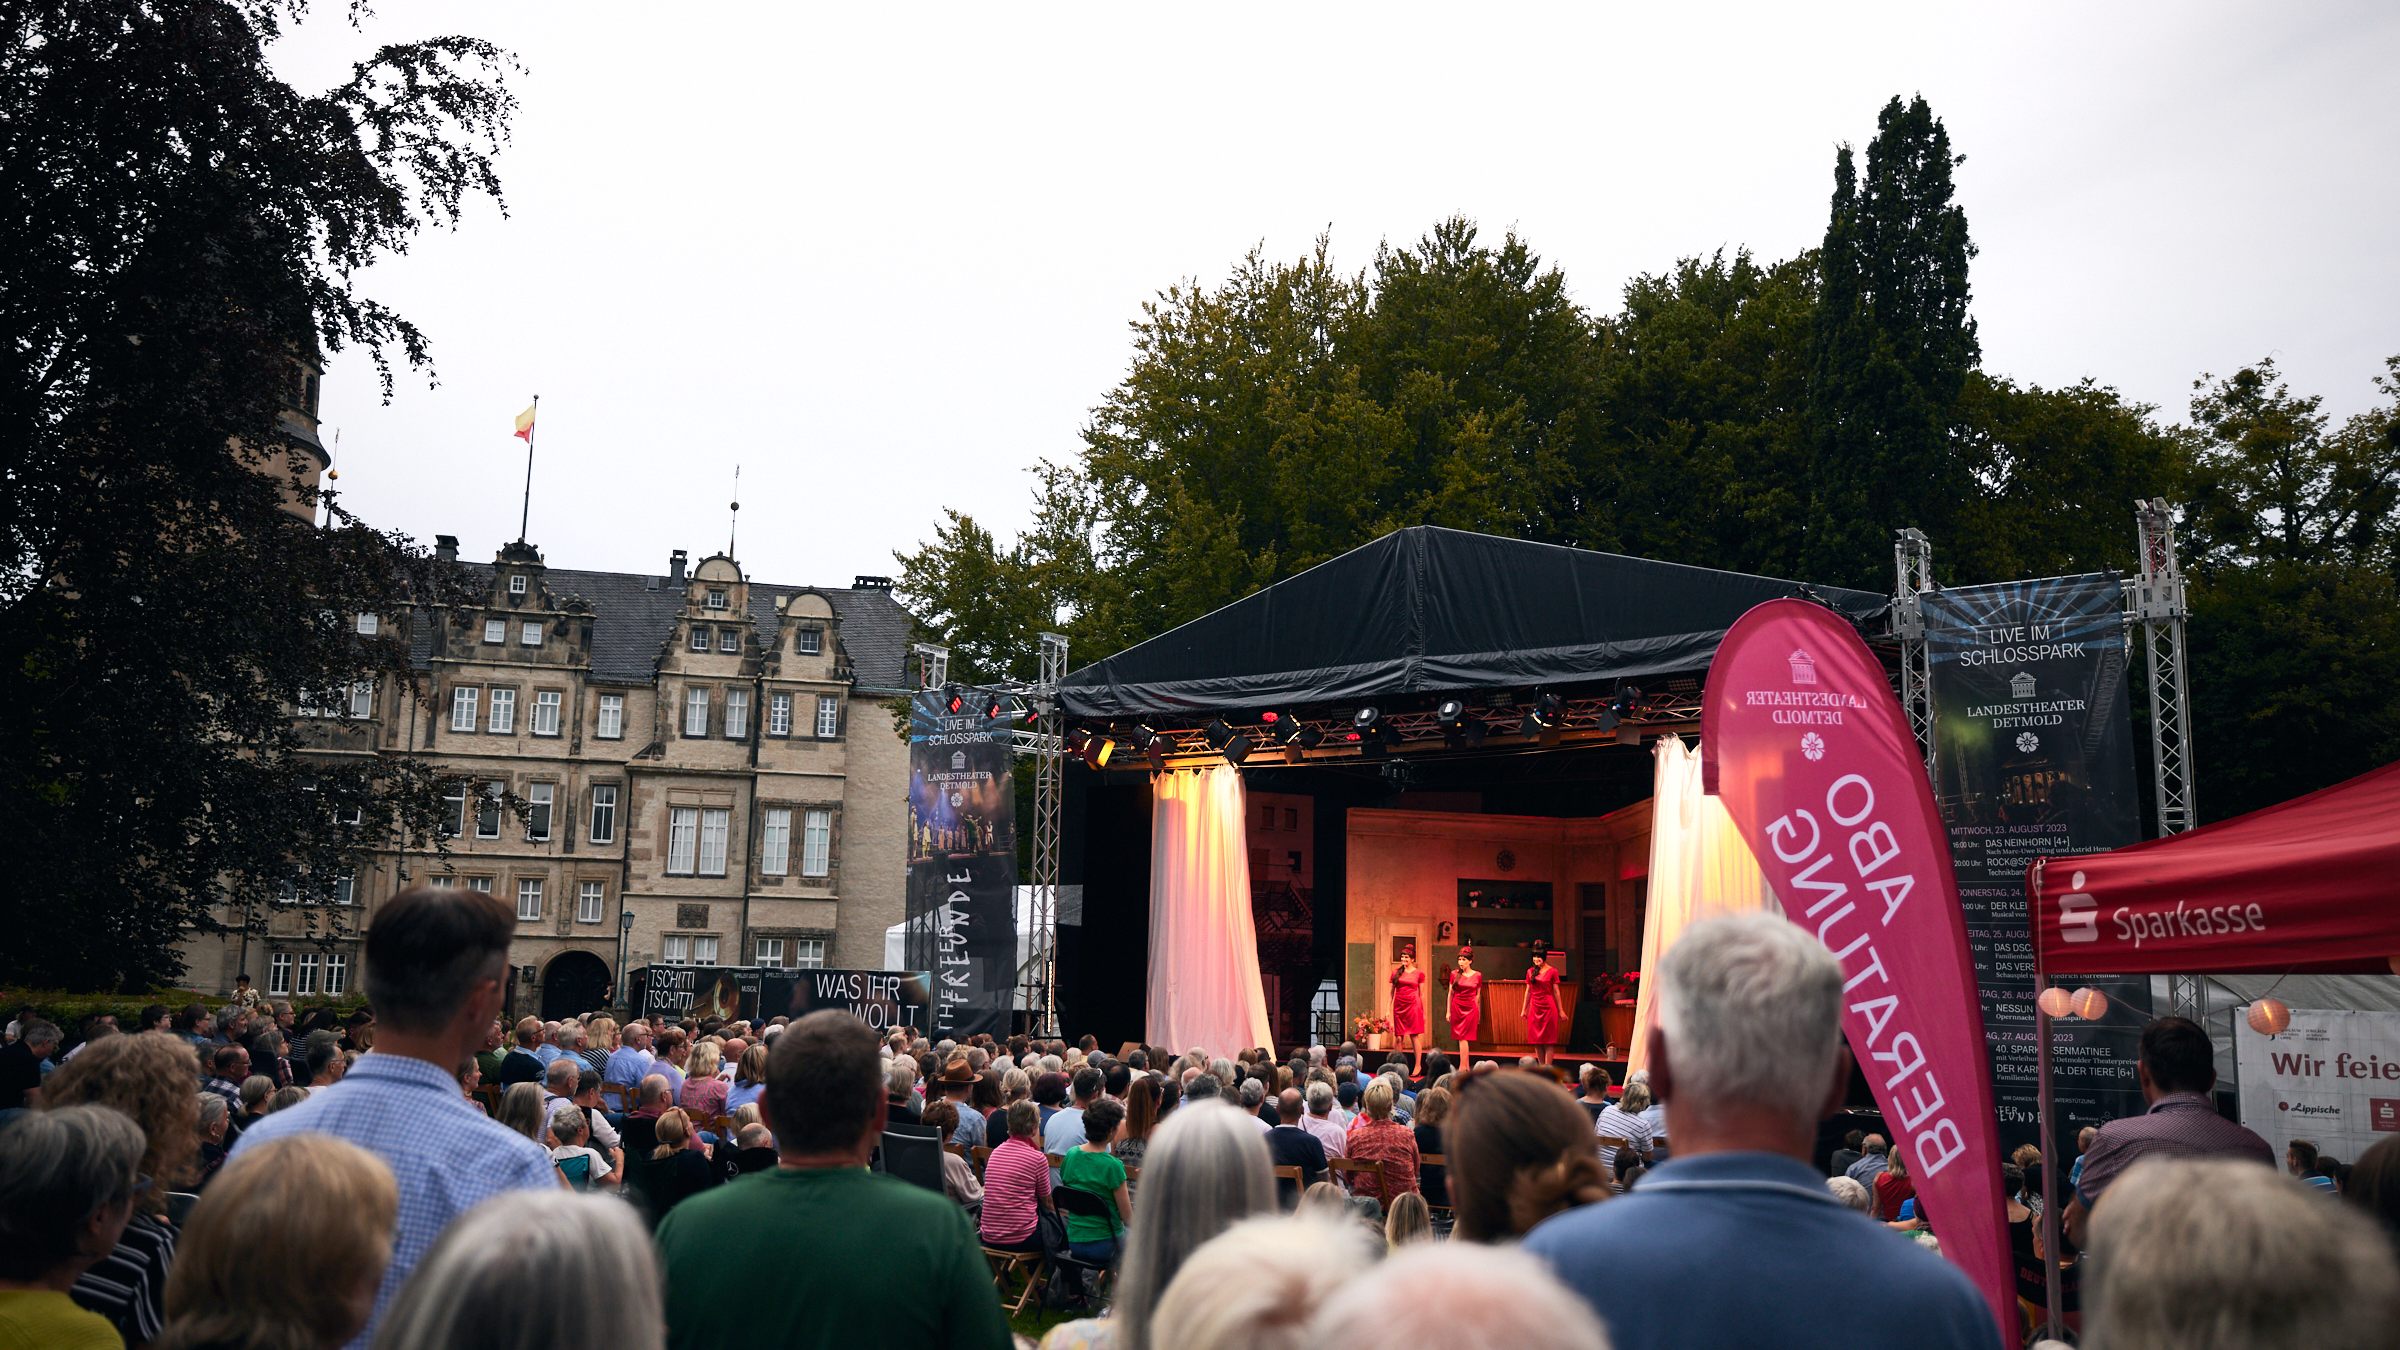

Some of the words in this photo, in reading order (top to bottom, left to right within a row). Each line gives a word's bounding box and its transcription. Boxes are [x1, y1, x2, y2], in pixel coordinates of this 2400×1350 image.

[1990, 626, 2026, 644] LIVE
[2030, 625, 2050, 641] IM
[1960, 642, 2086, 667] SCHLOSSPARK
[1967, 699, 2086, 717] LANDESTHEATER
[944, 719, 964, 731] LIVE
[965, 718, 975, 730] IM
[1993, 714, 2063, 728] DETMOLD
[928, 731, 994, 746] SCHLOSSPARK
[927, 771, 993, 782] LANDESTHEATER
[940, 781, 978, 790] DETMOLD
[1951, 826, 1994, 835] MITTWOCH,
[1995, 825, 2007, 834] 23.
[2009, 824, 2045, 834] AUGUST
[2046, 823, 2067, 832] 2023
[1968, 841, 1980, 849] Uhr:
[1985, 839, 2003, 848] DAS
[2004, 837, 2052, 847] NEINHORN
[2053, 836, 2070, 847] [4+]
[2070, 845, 2092, 853] Astrid
[2010, 888, 2023, 896] 24.
[1990, 901, 2008, 910] DER
[2112, 900, 2266, 949] Sparkasse
[1994, 943, 2011, 952] DAS
[1974, 962, 1989, 970] Uhr:
[1995, 962, 2013, 971] DAS
[650, 969, 696, 989] TSCHITTI
[816, 973, 862, 1000] WAS
[866, 975, 901, 1001] IHR
[649, 990, 695, 1010] TSCHITTI
[2002, 990, 2014, 998] 26.
[1996, 1004, 2033, 1013] NESSUN
[2001, 1032, 2013, 1040] 27.
[2053, 1033, 2074, 1042] 2023
[1995, 1044, 2009, 1054] 40.
[1996, 1063, 2015, 1073] DER
[2067, 1066, 2087, 1076] DER
[2088, 1067, 2115, 1077] TIERE
[2117, 1066, 2134, 1079] [6+]
[2270, 1052, 2326, 1077] Wir
[2290, 1102, 2341, 1115] Lippische
